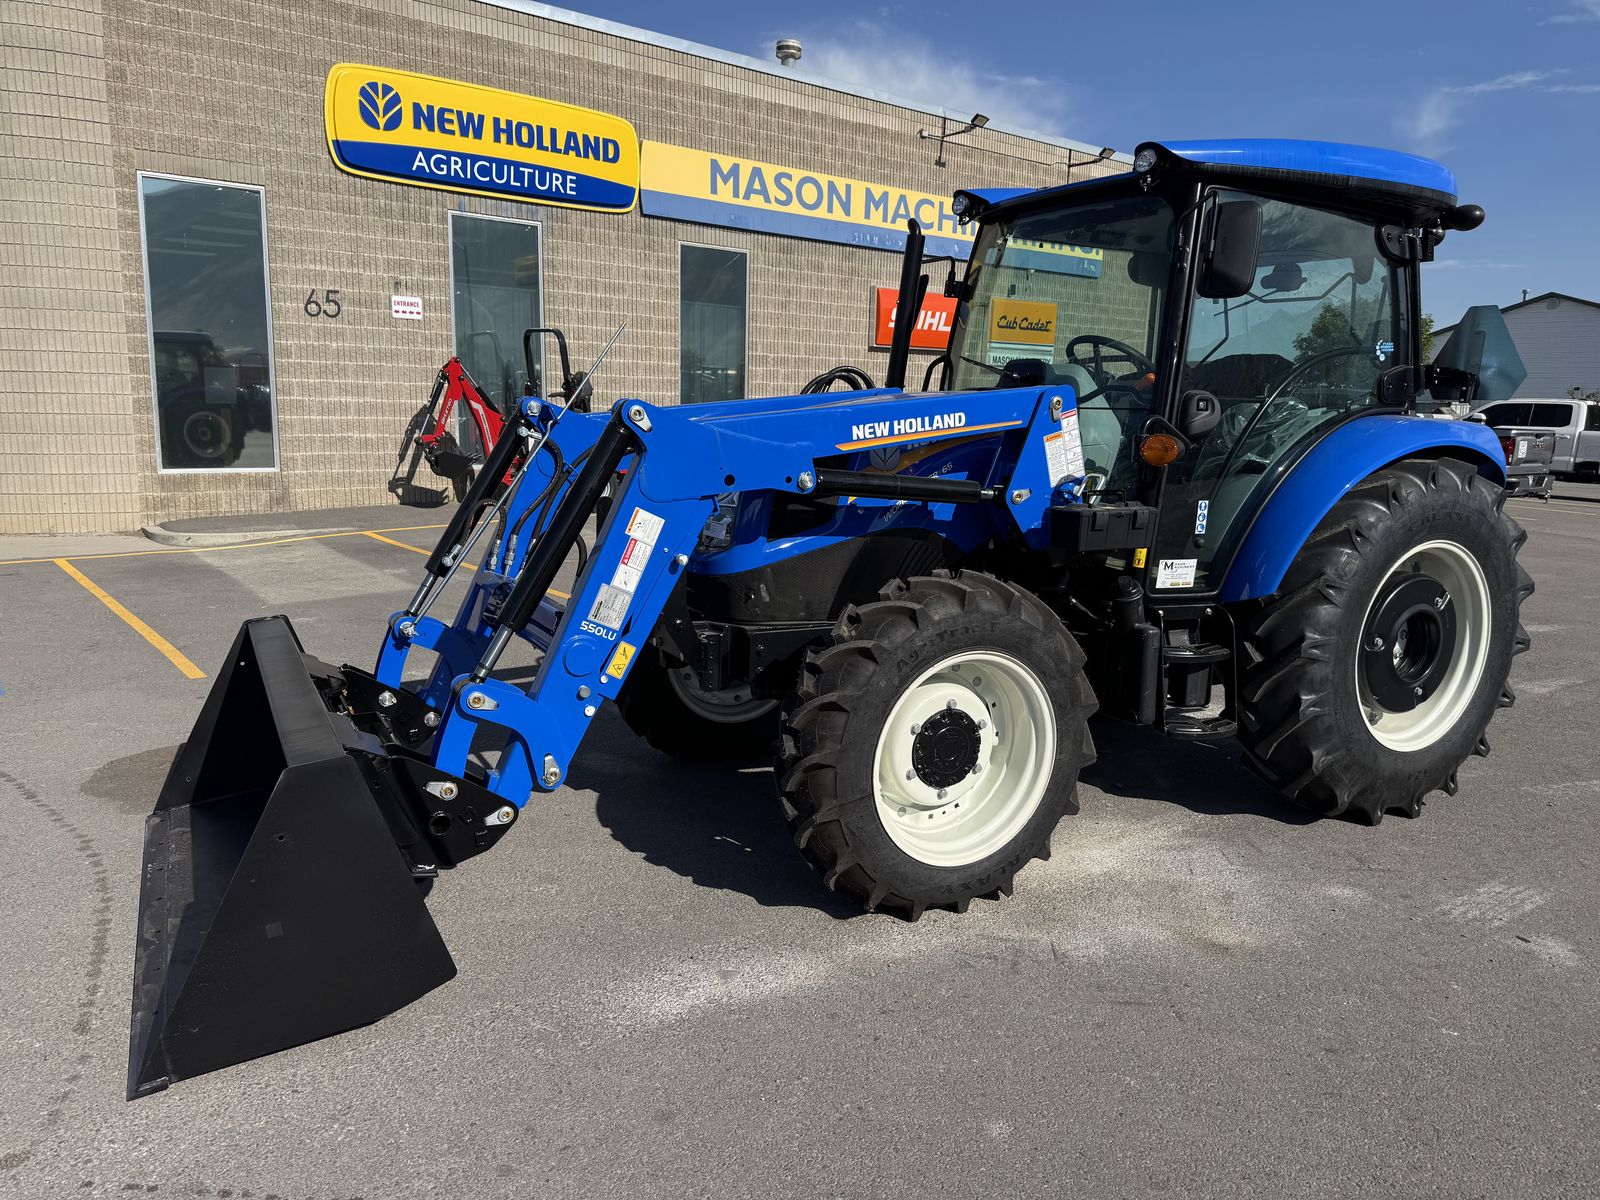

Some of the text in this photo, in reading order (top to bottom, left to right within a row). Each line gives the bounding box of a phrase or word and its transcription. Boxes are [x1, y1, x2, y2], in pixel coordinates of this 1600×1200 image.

[412, 102, 621, 164] NEW HOLLAND
[412, 150, 577, 196] AGRICULTURE
[710, 158, 977, 237] MASON MACH
[304, 288, 341, 318] 65
[393, 300, 420, 308] ENTRANCE
[888, 307, 952, 332] SIHL
[997, 315, 1052, 332] Cub Cadet
[851, 412, 966, 440] NEW HOLLAND
[580, 620, 617, 640] 550LU
